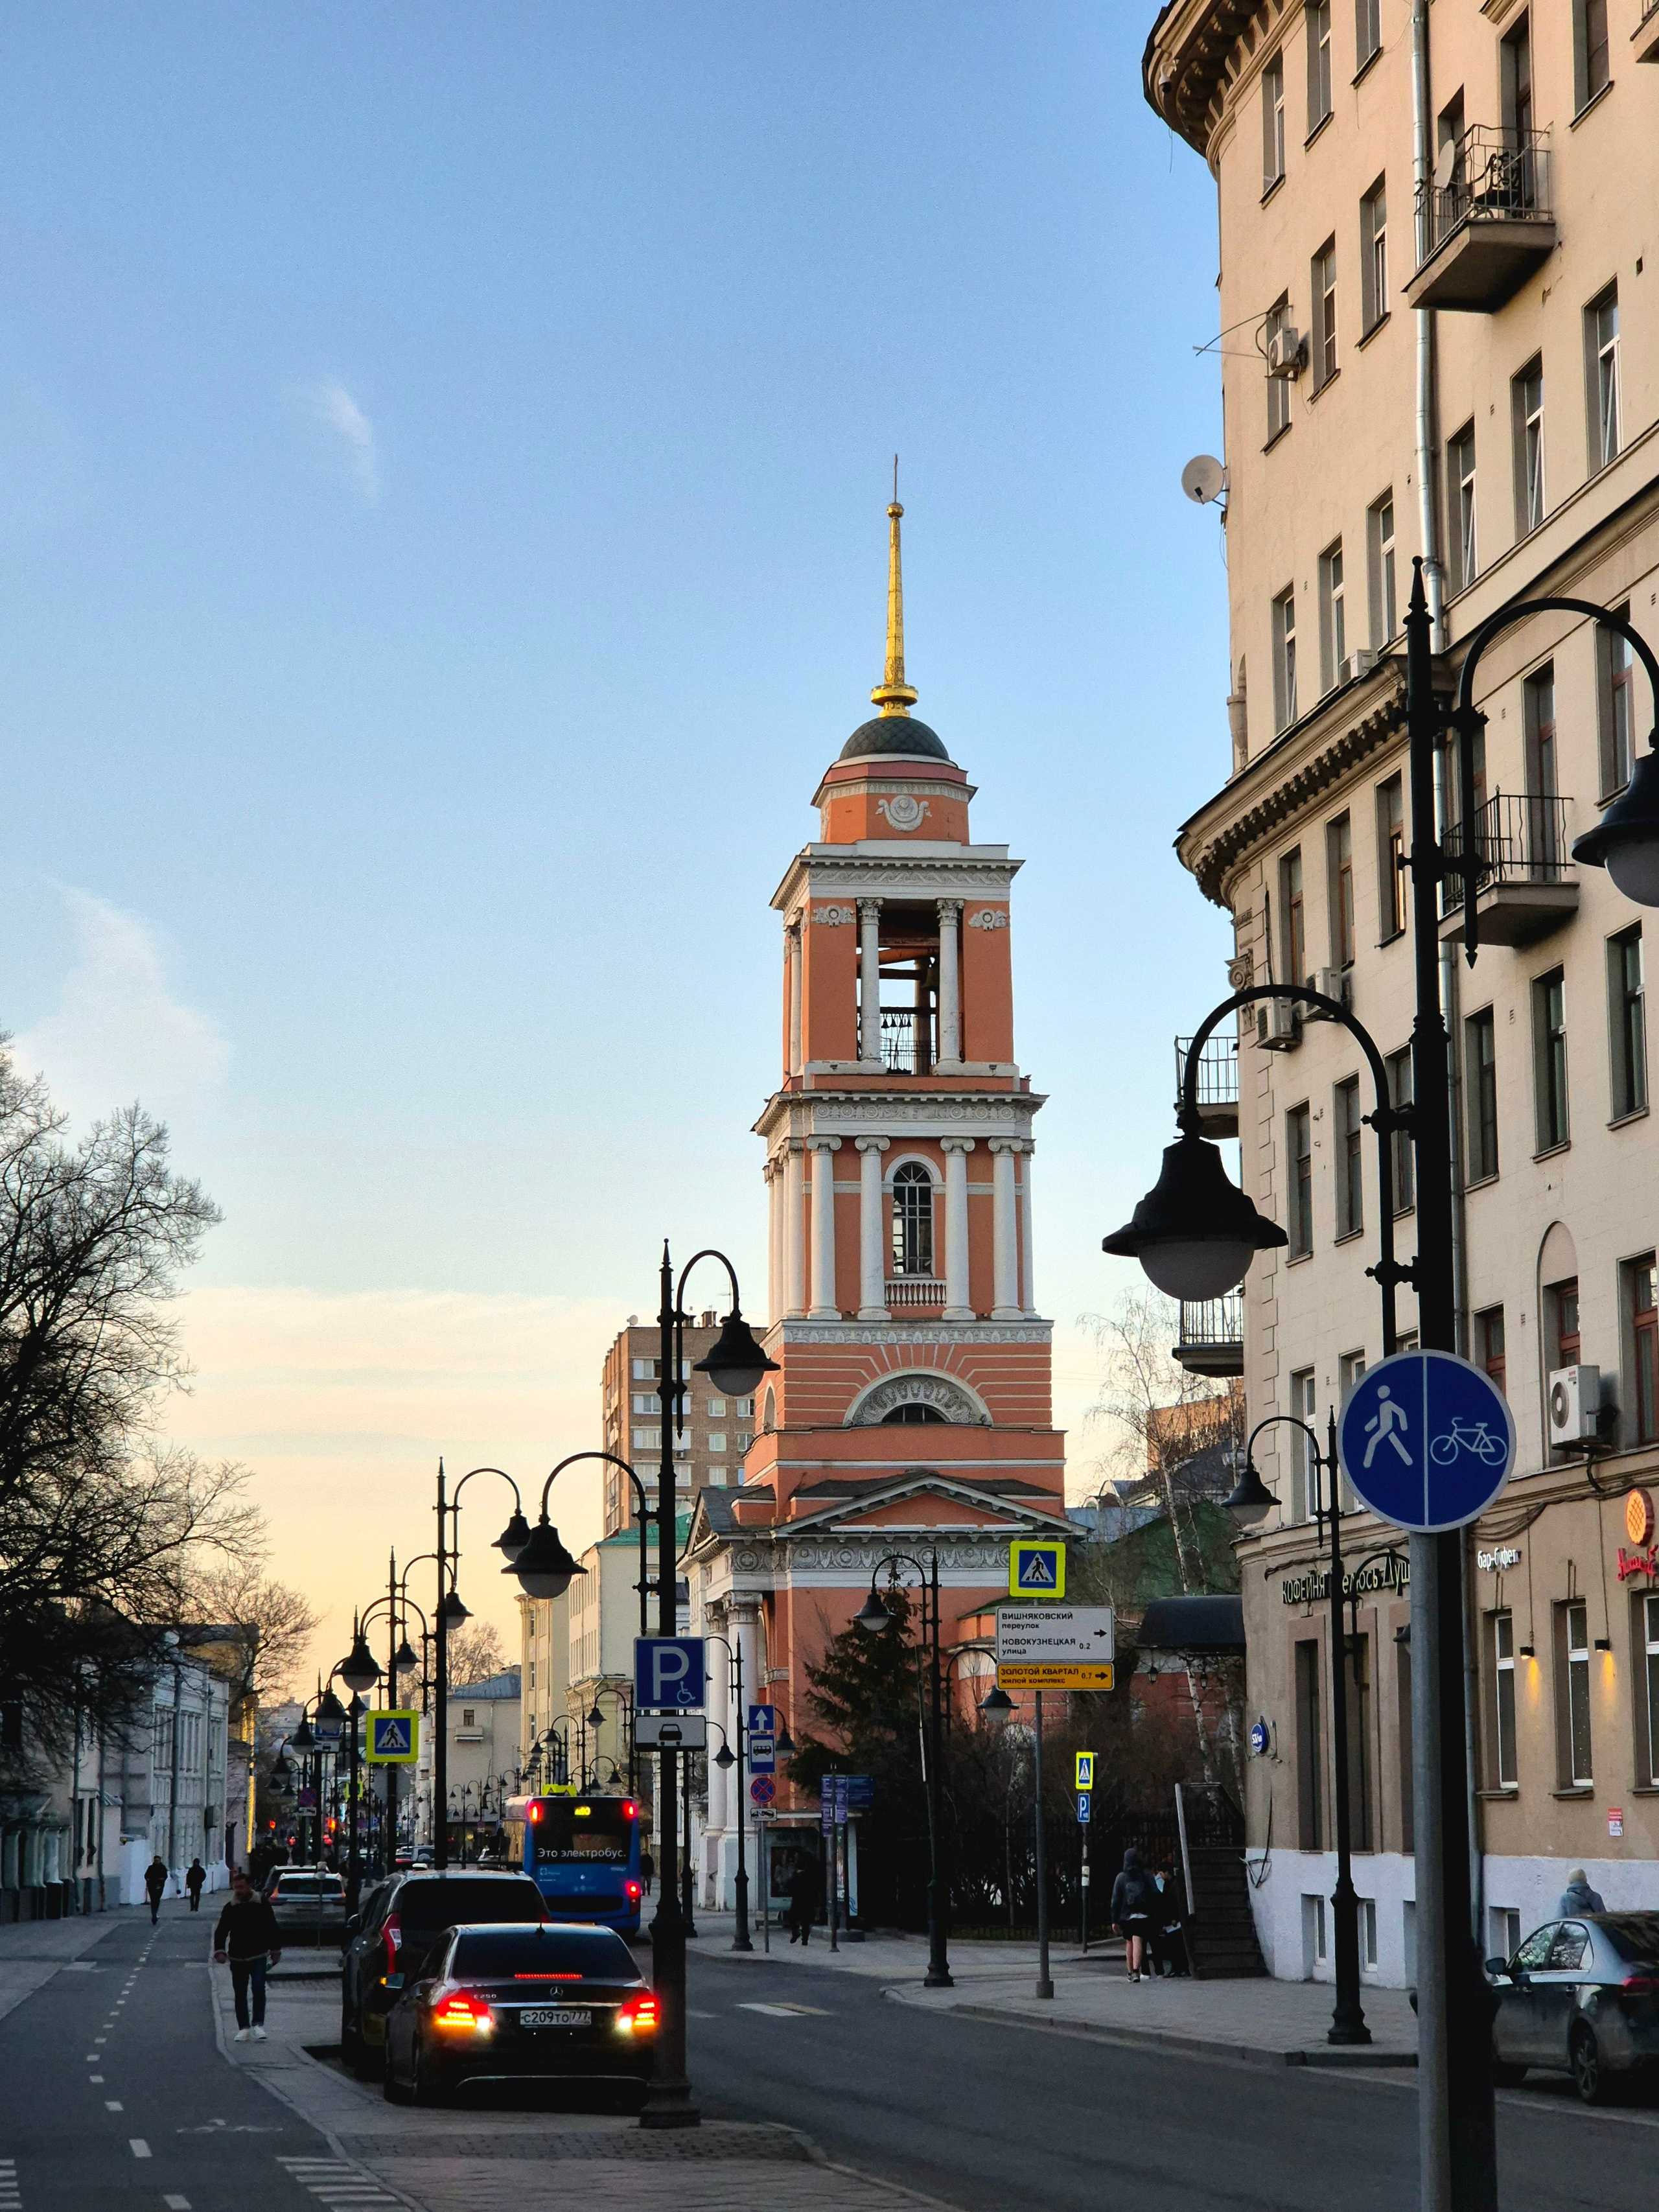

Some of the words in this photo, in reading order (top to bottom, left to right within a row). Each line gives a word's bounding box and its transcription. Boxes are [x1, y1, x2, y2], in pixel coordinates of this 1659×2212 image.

[1478, 1546, 1517, 1572] бар-буфет
[1282, 1570, 1325, 1603] КОФЕЙНЯ
[1342, 1567, 1378, 1594] елюсь
[1381, 1548, 1410, 1595] Душ
[1002, 1612, 1073, 1620] ВИШНЯКОВСКИЙ
[653, 1646, 690, 1701] P
[1001, 1667, 1040, 1675] ЗОЛОТОЙ
[1079, 1797, 1087, 1819] P
[538, 1848, 558, 1857] Это
[561, 1848, 627, 1859] электробус.
